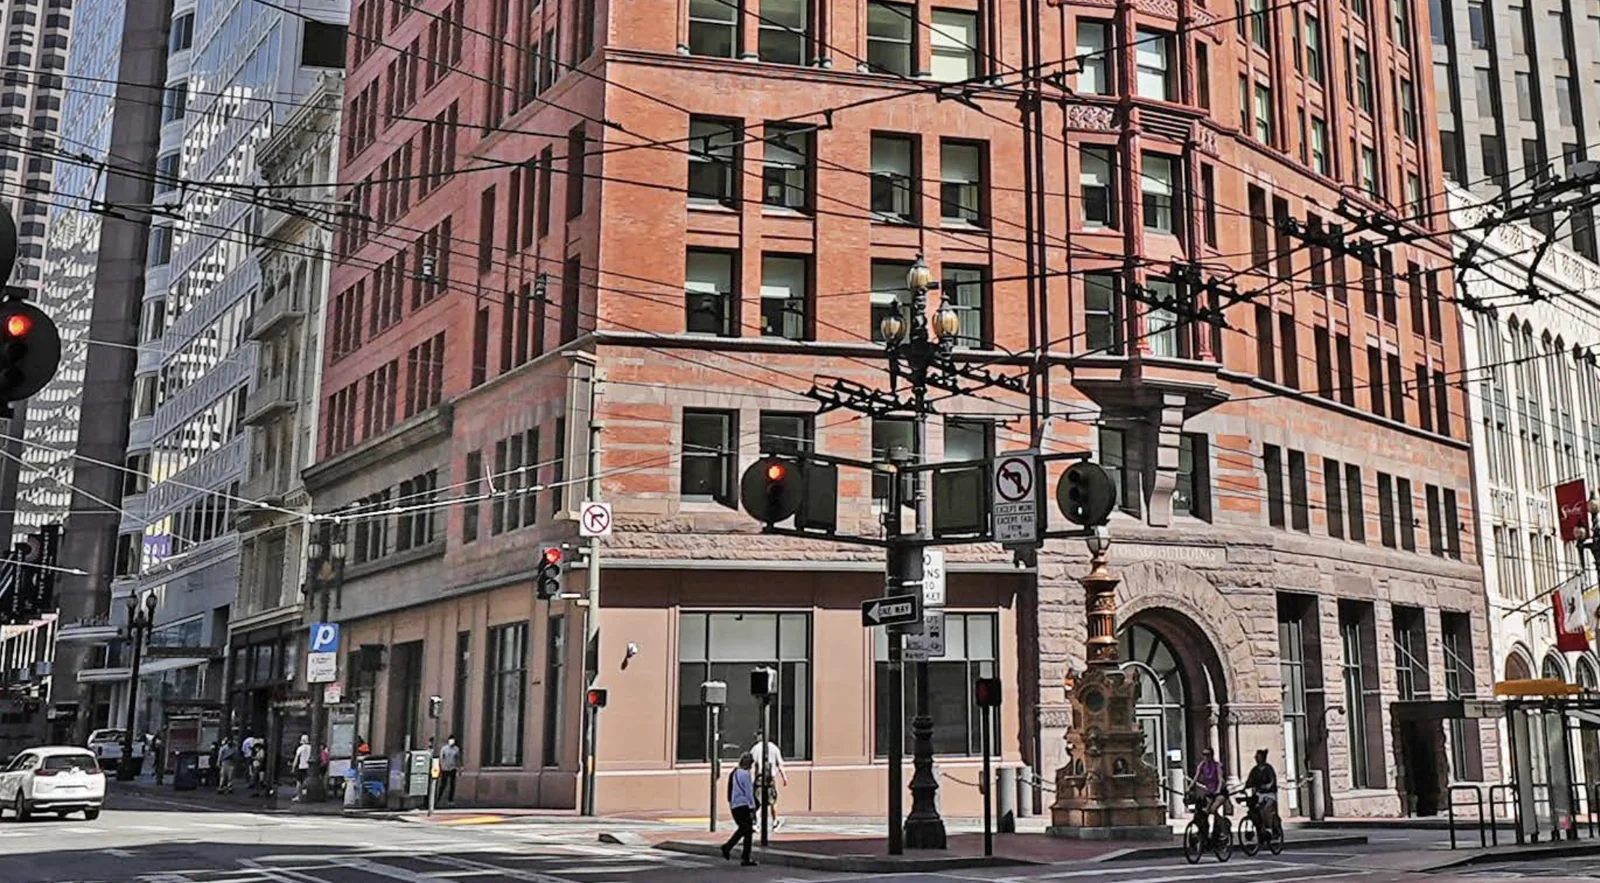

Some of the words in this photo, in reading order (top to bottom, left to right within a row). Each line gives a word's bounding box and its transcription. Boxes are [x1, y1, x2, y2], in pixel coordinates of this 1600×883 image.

[997, 516, 1018, 525] EXCEPT
[1159, 546, 1216, 561] BUILDING
[924, 554, 932, 566] O
[878, 606, 891, 616] ONE
[895, 604, 909, 613] WAY
[313, 625, 336, 651] P
